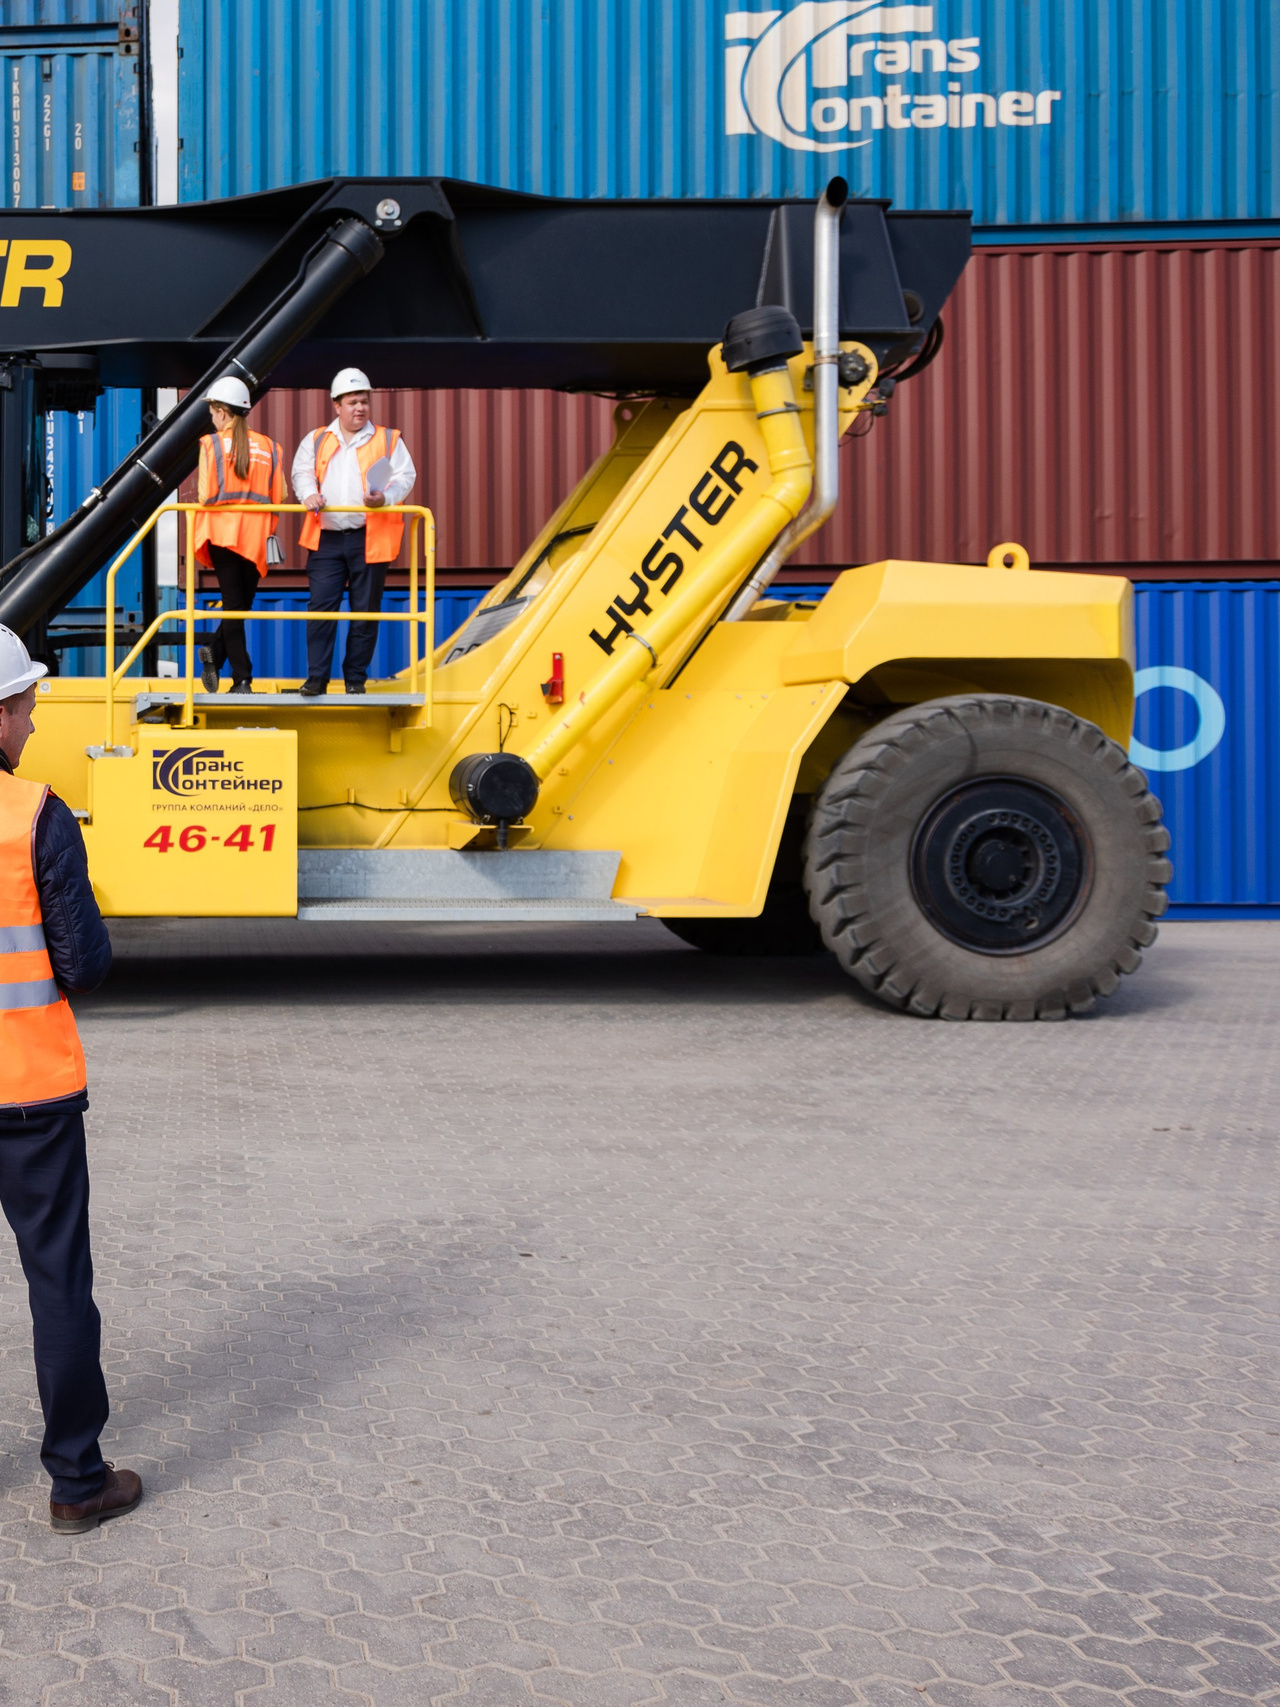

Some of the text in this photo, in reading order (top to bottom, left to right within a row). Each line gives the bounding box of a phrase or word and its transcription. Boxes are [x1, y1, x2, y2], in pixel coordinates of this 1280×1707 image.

[725, 0, 981, 88] Trans
[43, 94, 52, 151] 22G1
[74, 122, 83, 150] 20
[589, 440, 760, 657] HYSTER
[153, 747, 244, 775] Транс
[152, 804, 187, 812] ГРУППА
[190, 802, 246, 812] КОМПАНИЙ
[143, 824, 276, 853] 46-41
